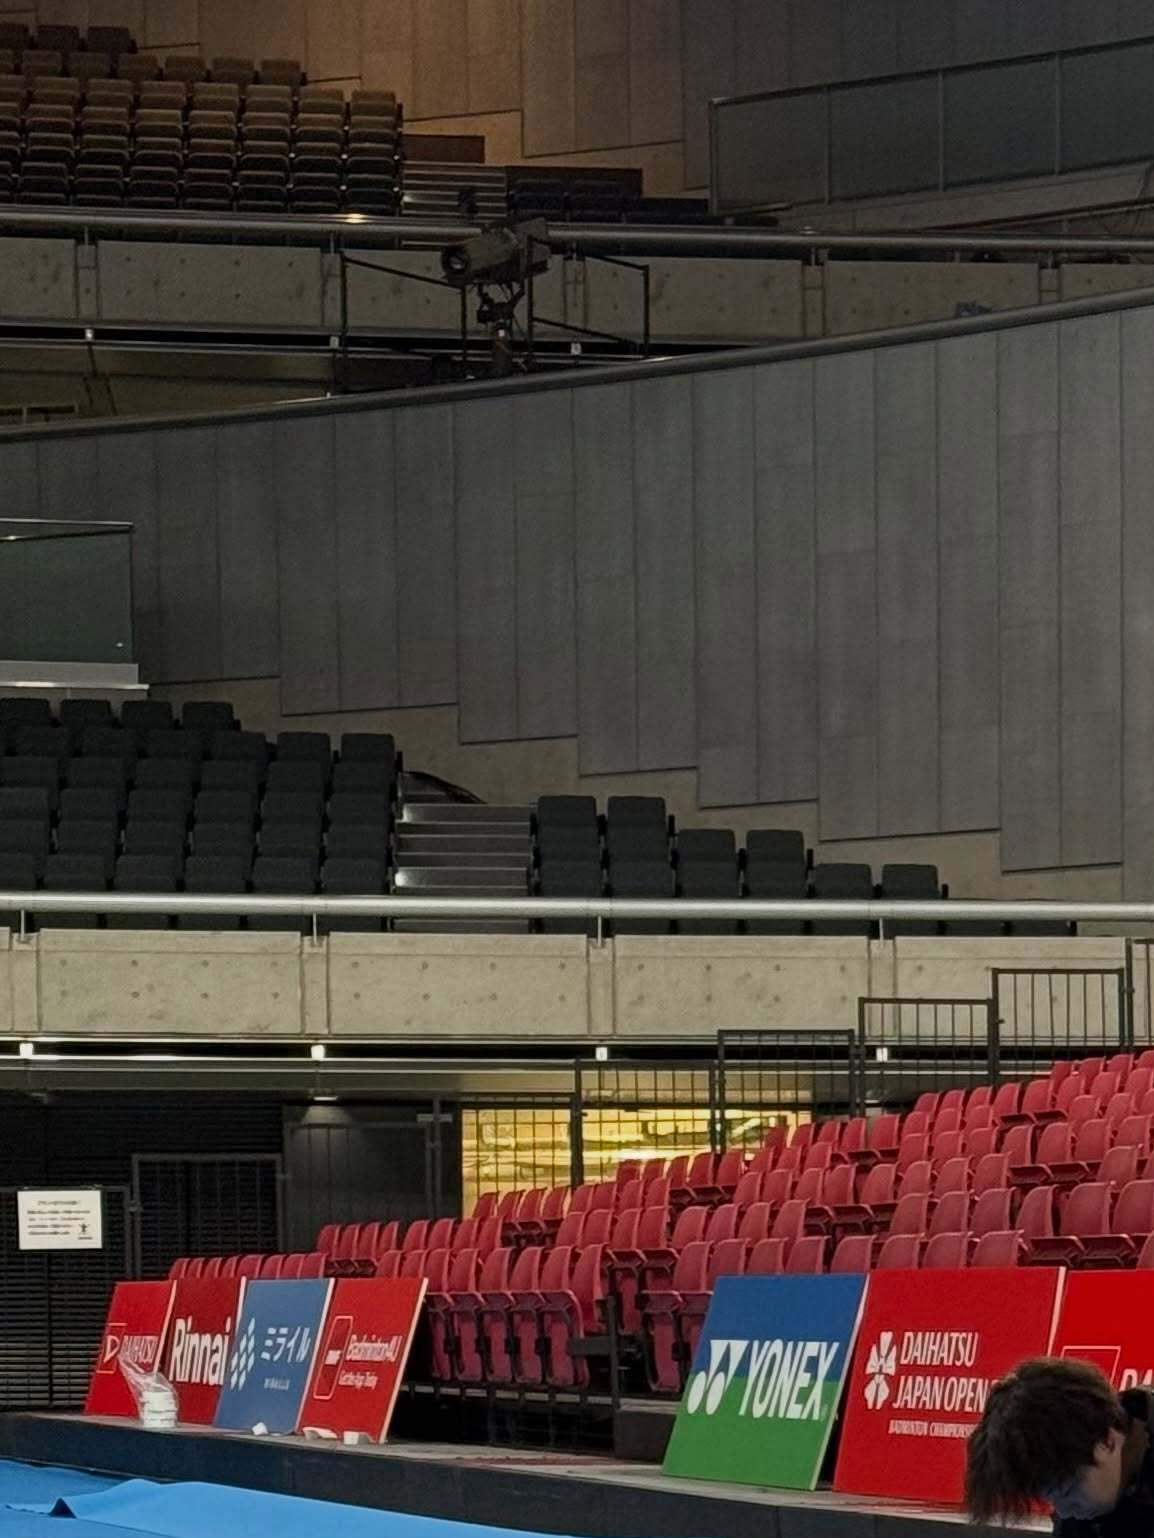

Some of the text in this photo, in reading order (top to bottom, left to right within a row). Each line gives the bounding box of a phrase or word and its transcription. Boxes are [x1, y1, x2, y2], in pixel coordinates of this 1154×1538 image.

[168, 1316, 232, 1386] Rinnai
[261, 1326, 312, 1363] ミライル
[900, 1331, 979, 1367] DAIHATSU
[738, 1339, 840, 1420] YONEX
[892, 1375, 988, 1413] JAPAN OPEN
